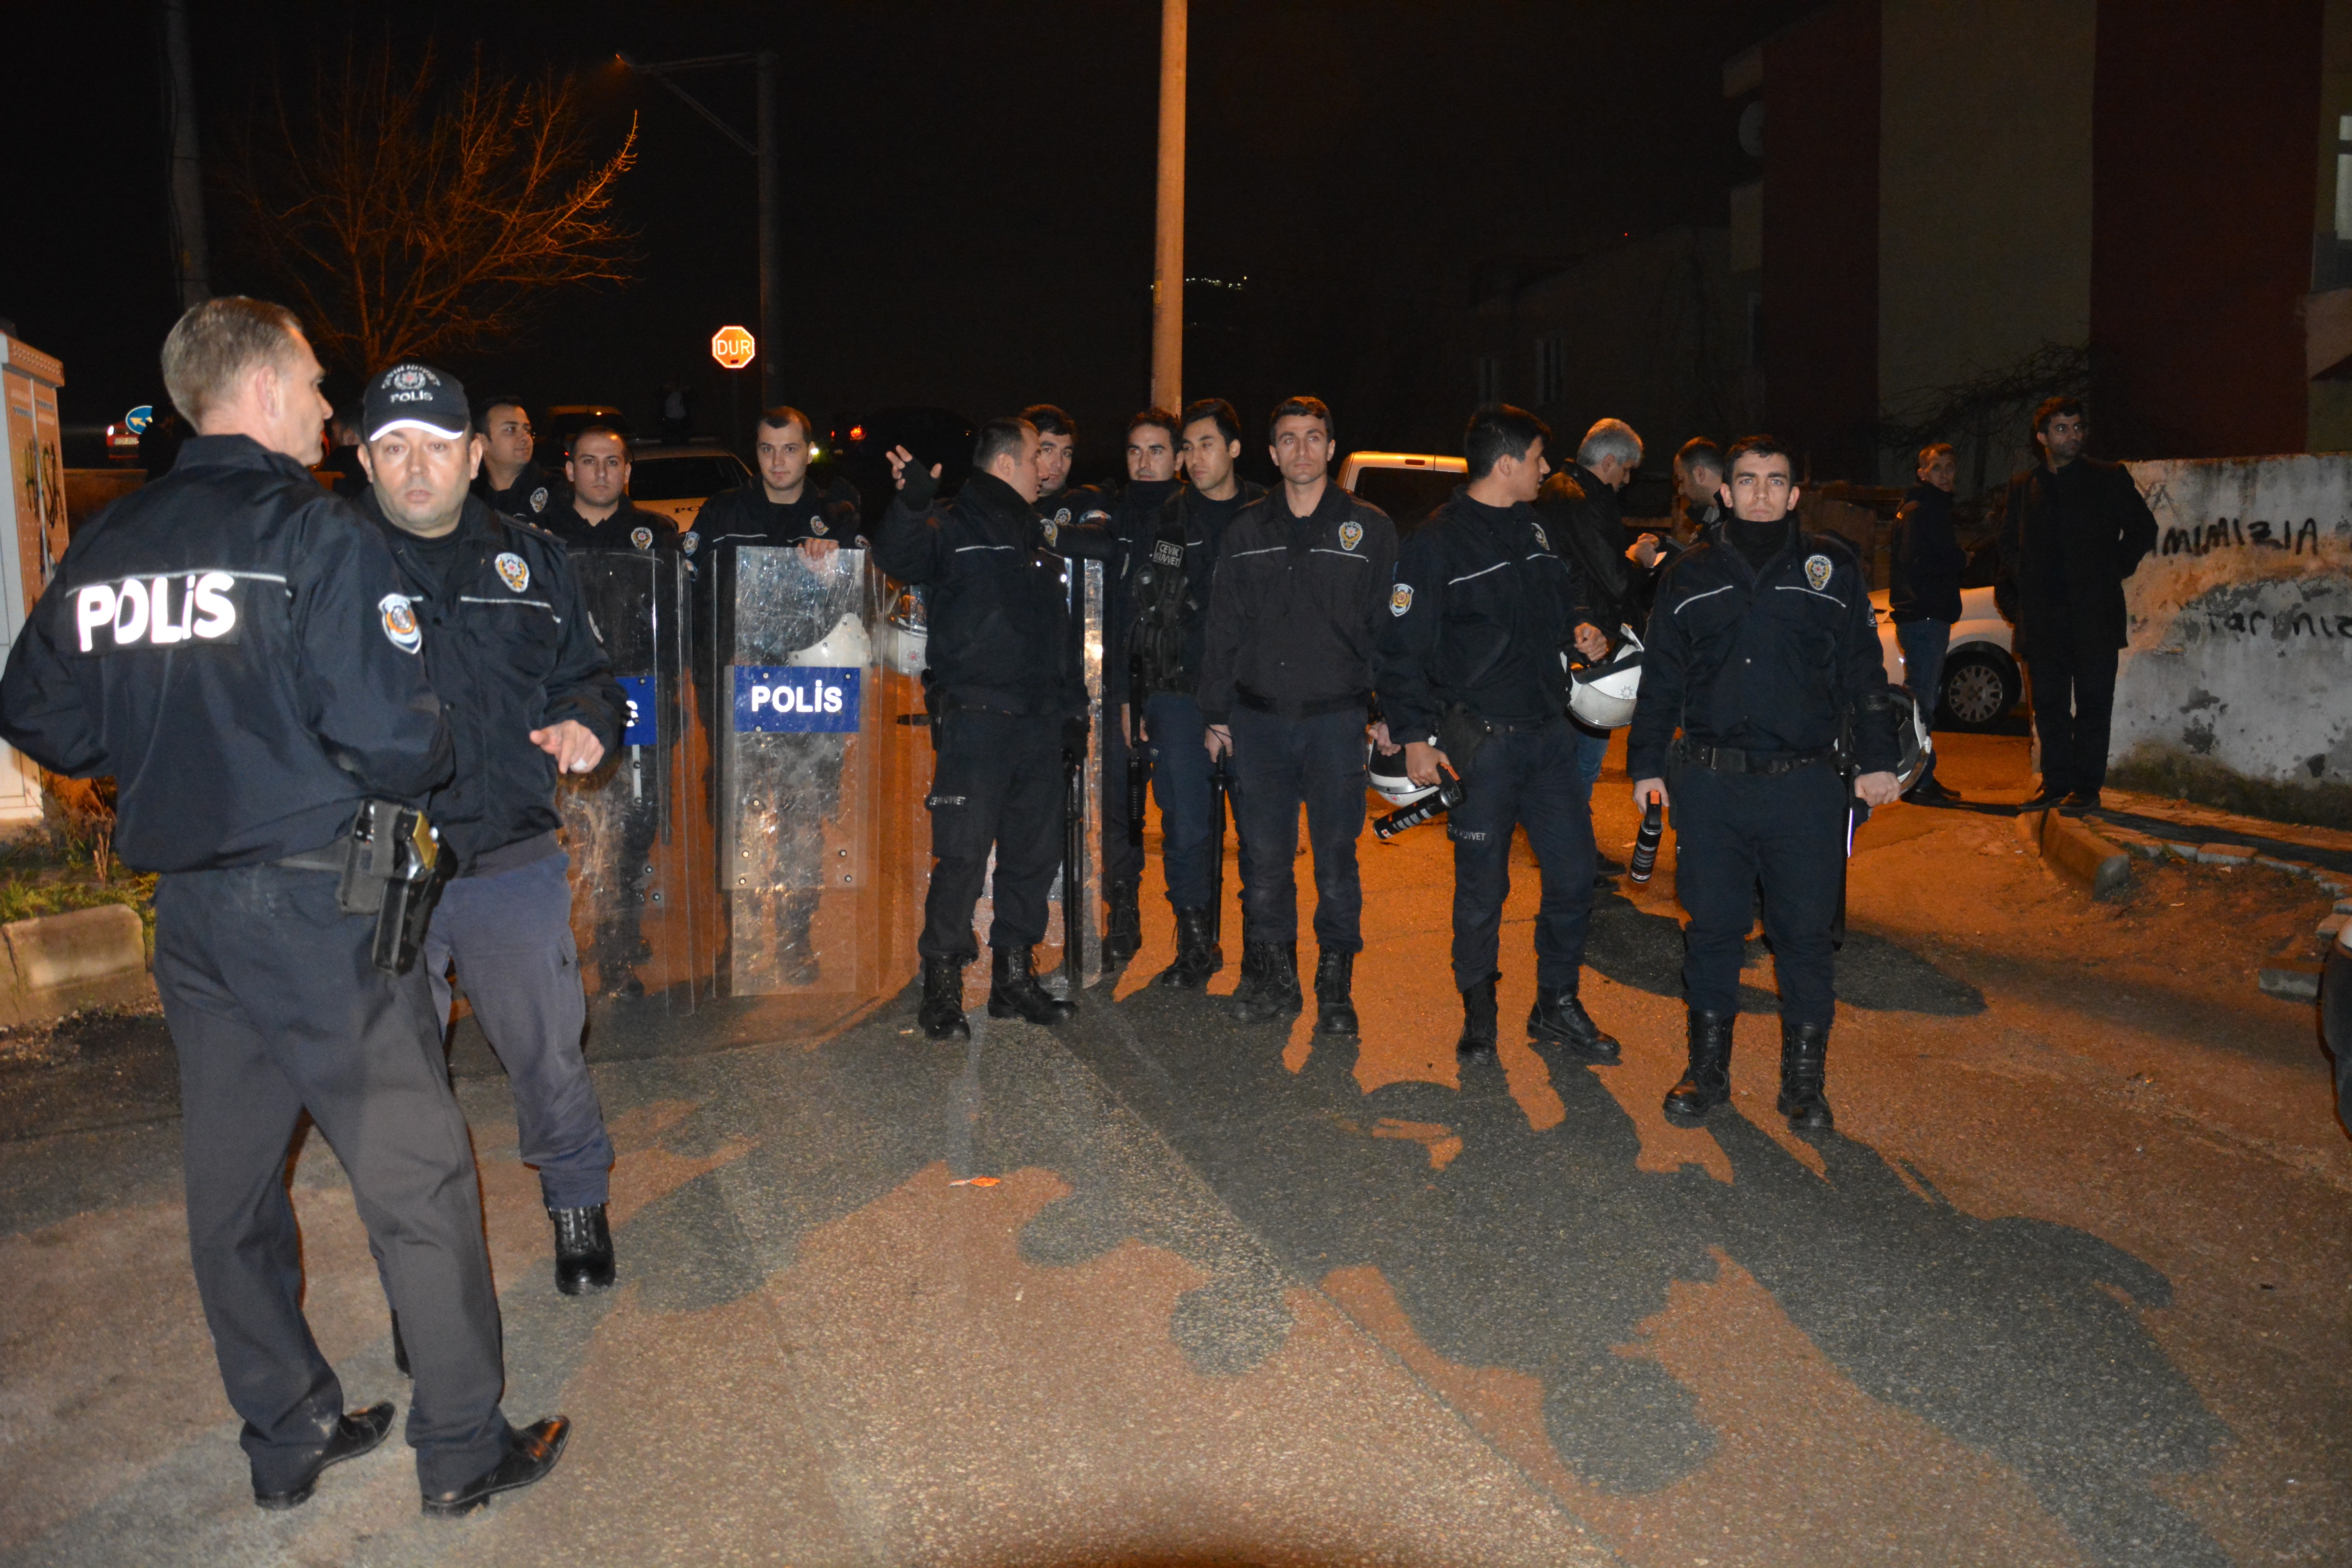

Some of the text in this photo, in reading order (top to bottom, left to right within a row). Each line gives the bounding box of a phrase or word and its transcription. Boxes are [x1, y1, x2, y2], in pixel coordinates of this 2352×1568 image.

[717, 340, 750, 355] DUR
[390, 390, 433, 403] POLİS
[1154, 552, 1180, 566] KUVVET
[78, 572, 236, 652] POLİS
[751, 680, 842, 713] POLİS
